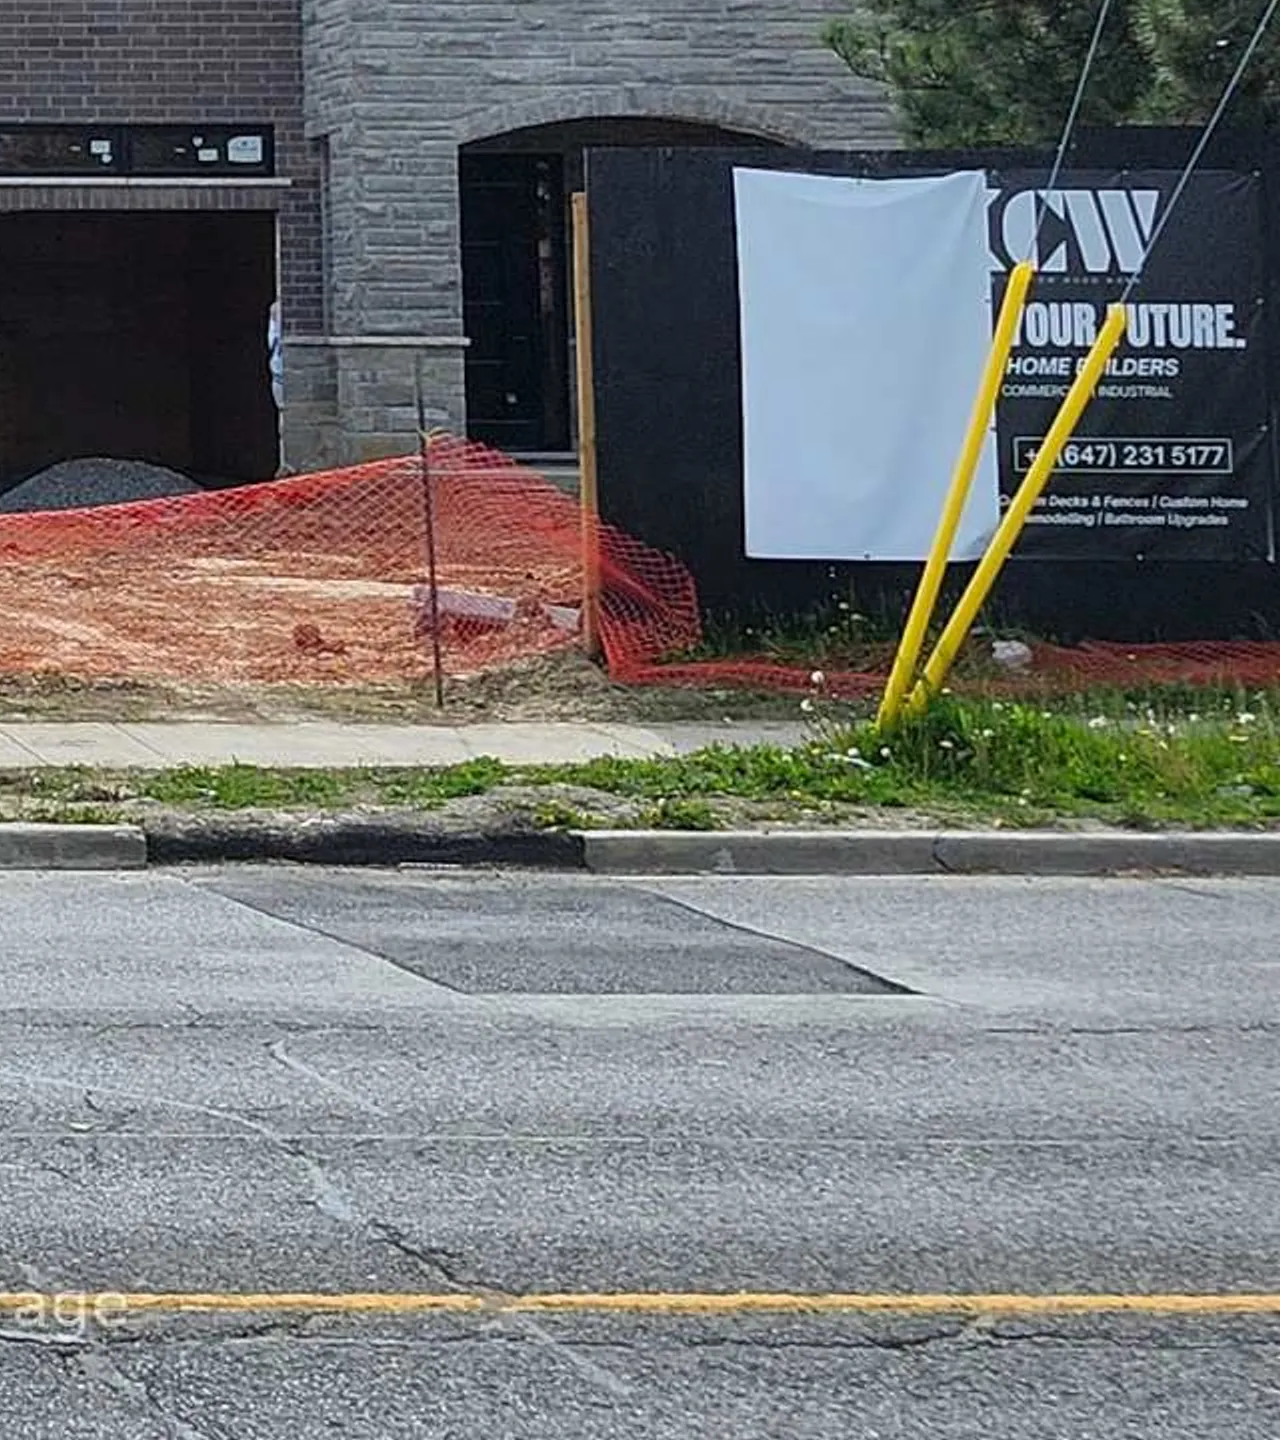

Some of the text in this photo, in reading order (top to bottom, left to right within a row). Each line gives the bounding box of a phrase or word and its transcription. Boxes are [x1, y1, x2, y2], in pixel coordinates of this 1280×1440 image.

[987, 189, 1160, 273] CW
[1011, 303, 1246, 348] OUR UTURE.
[1006, 357, 1072, 376] HOME
[1097, 384, 1173, 399] INDUSTRIAL
[1123, 446, 1164, 466] 231
[1172, 446, 1225, 467] 5177
[1104, 495, 1150, 508] Fences
[1159, 496, 1209, 508] Custom
[1104, 513, 1165, 526] Bathroom
